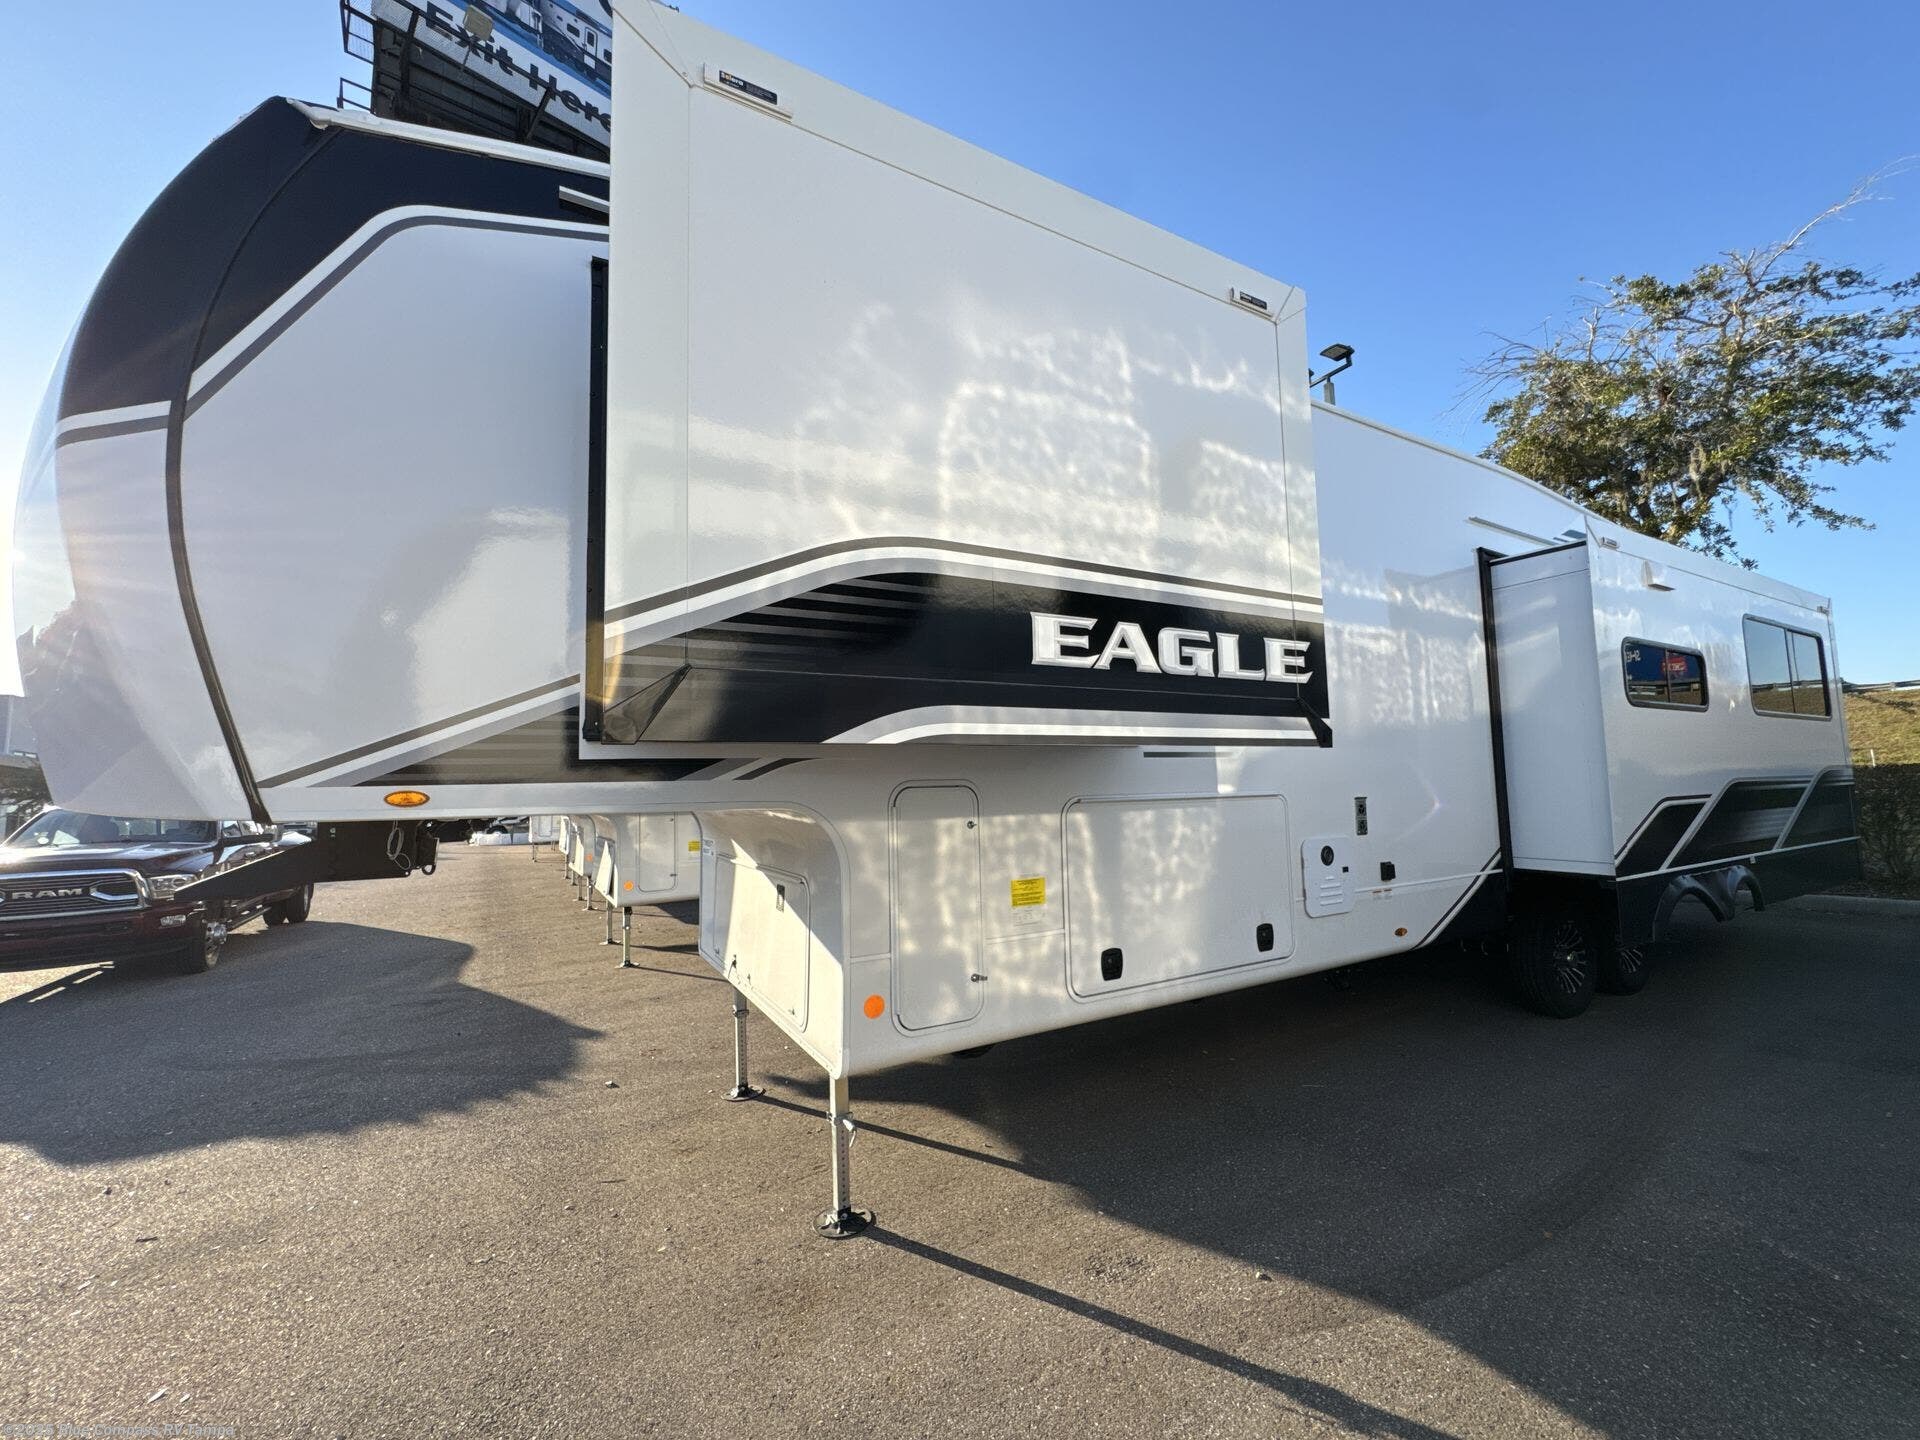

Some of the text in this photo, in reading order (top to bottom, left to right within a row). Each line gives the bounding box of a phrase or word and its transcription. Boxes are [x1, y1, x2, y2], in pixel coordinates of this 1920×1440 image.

[426, 1, 513, 76] Exit
[1030, 611, 1313, 684] EAGLE
[12, 888, 82, 900] RAM
